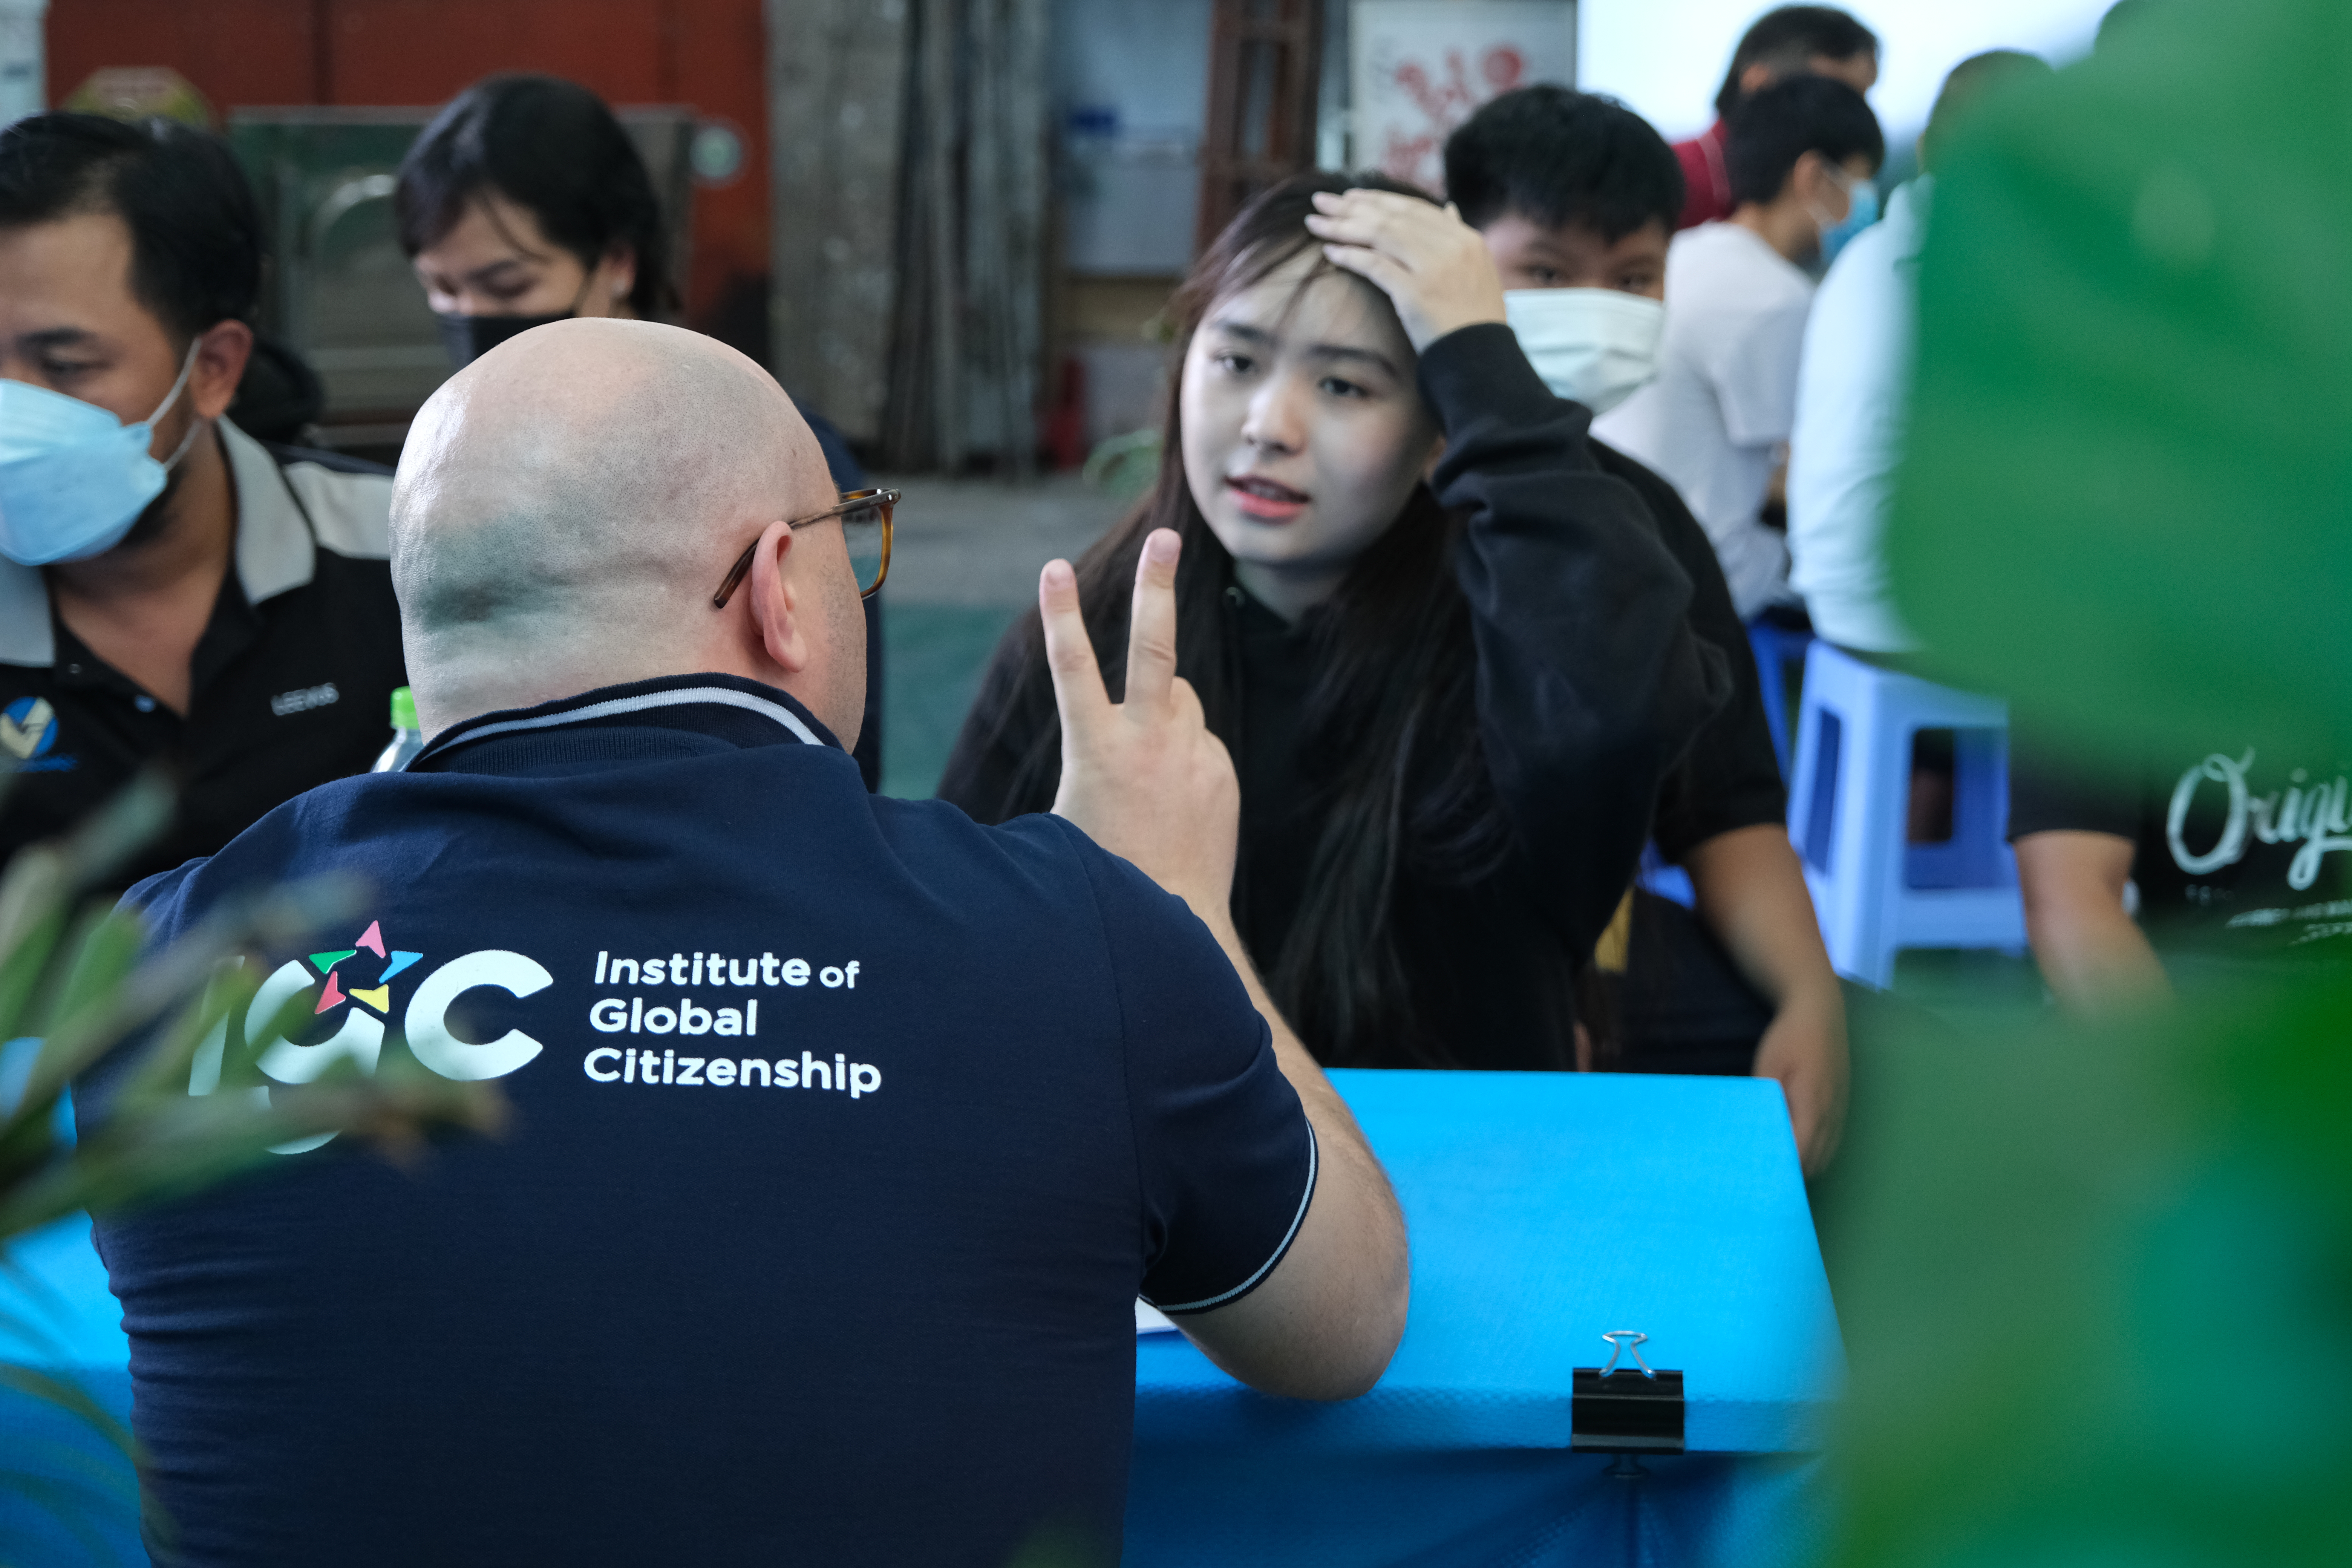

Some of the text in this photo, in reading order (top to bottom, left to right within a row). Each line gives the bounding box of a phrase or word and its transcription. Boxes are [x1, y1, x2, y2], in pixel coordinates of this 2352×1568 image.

[594, 950, 860, 988] Institute of
[590, 997, 758, 1035] Global
[583, 1047, 882, 1099] Citizenship
